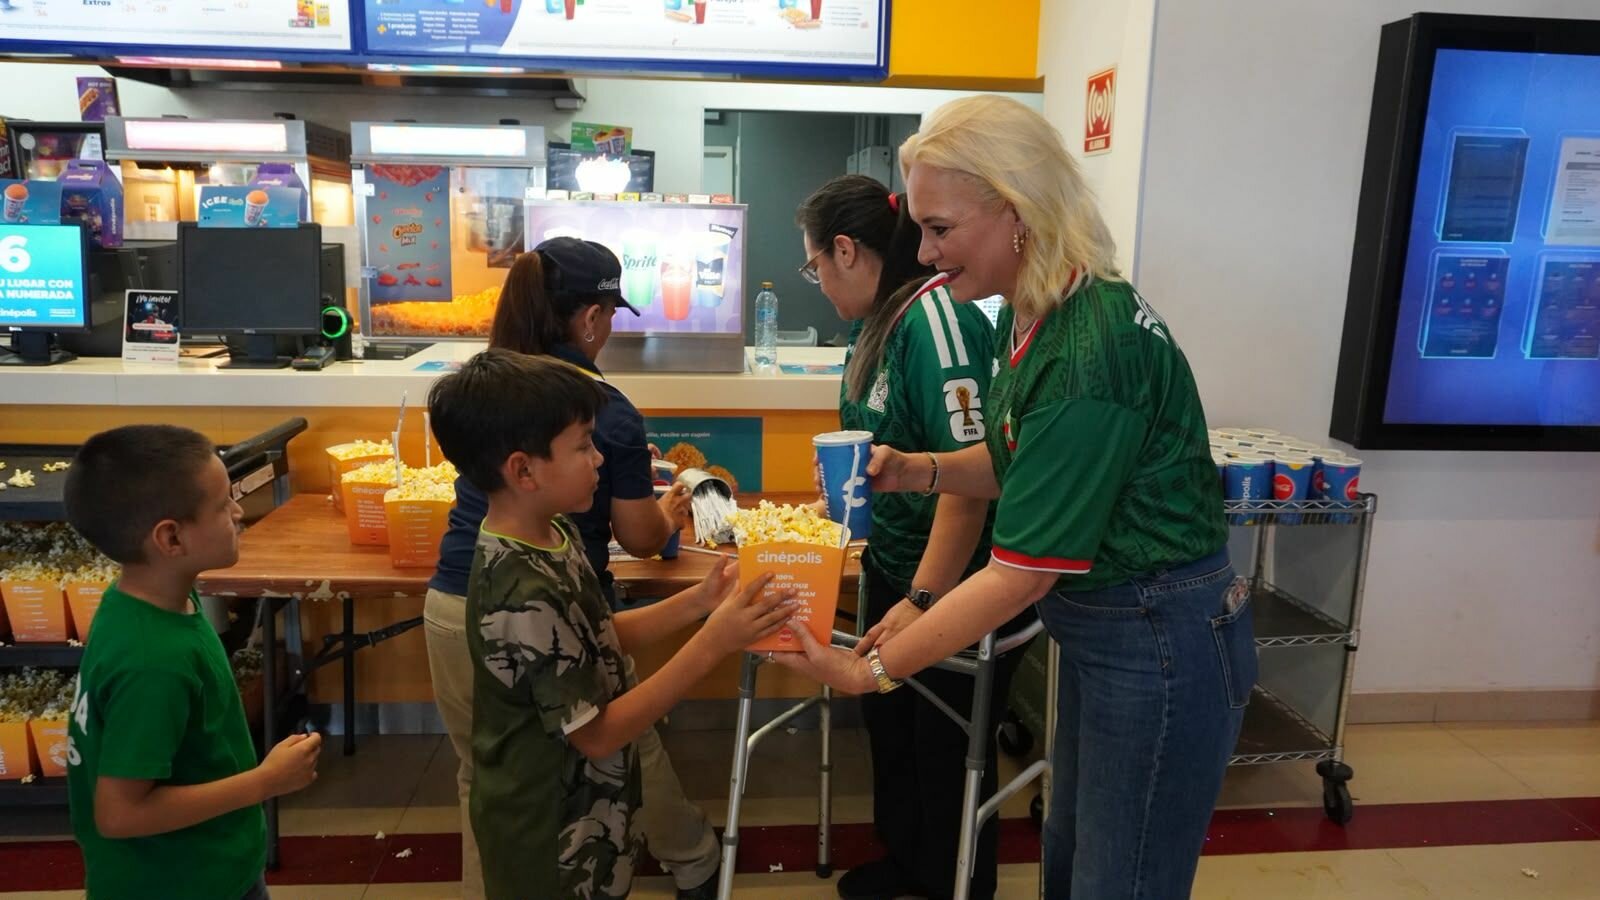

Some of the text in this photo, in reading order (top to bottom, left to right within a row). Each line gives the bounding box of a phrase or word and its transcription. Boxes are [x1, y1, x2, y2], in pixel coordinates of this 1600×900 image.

[7, 279, 46, 288] LUGAR
[48, 280, 73, 289] CON
[7, 290, 74, 300] NUMERADA
[963, 427, 979, 436] FIFA
[757, 551, 822, 565] cinépolis
